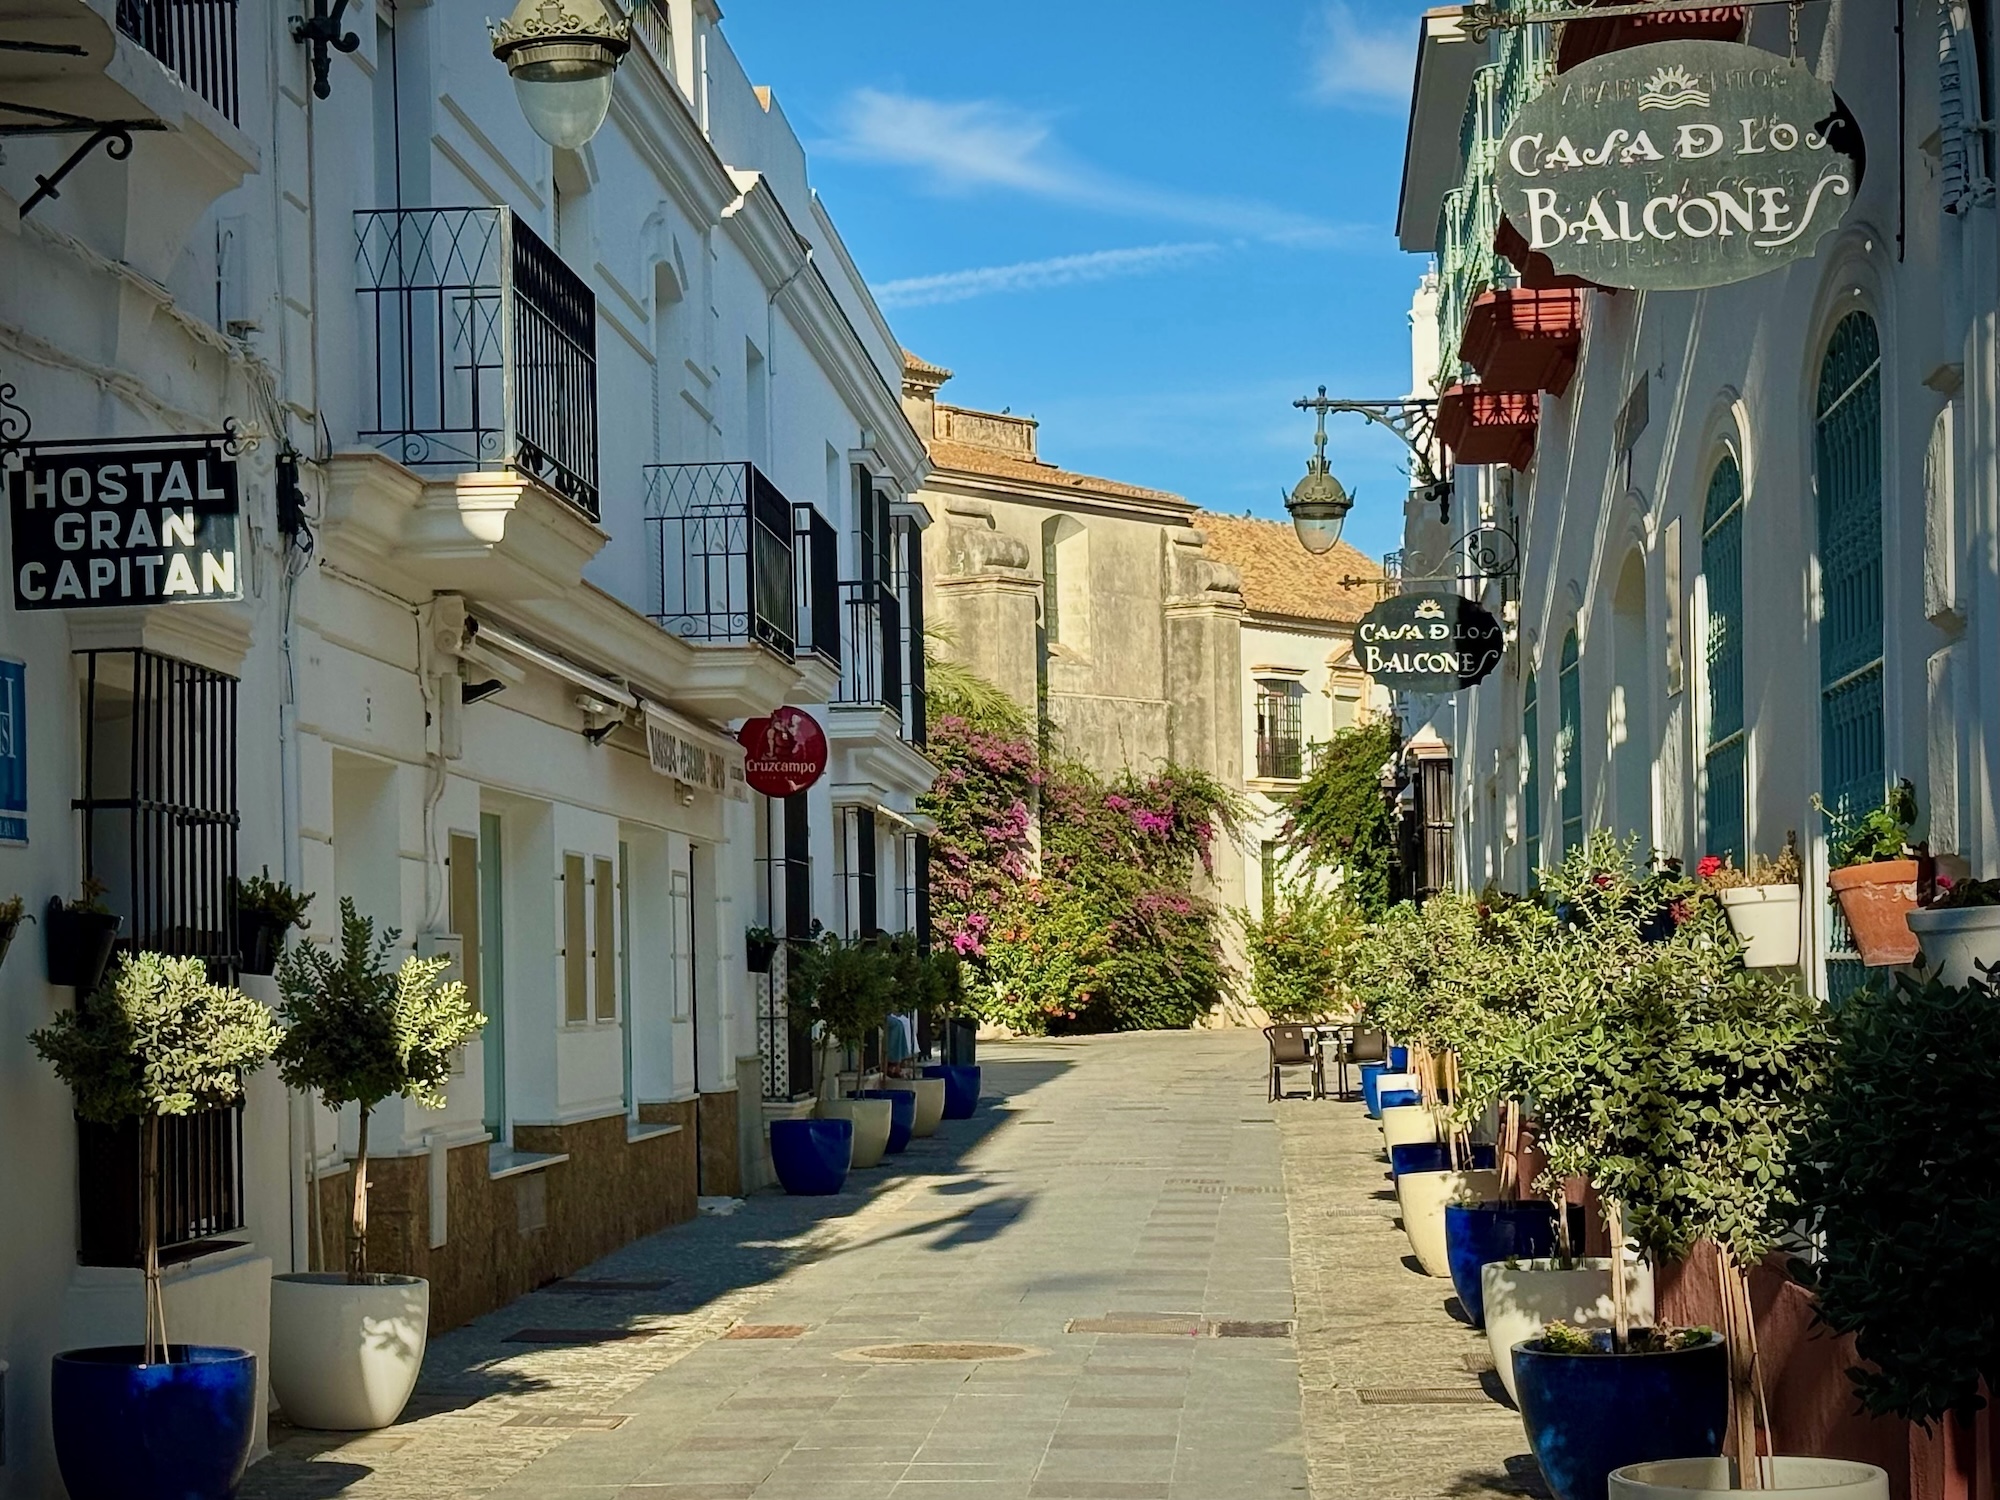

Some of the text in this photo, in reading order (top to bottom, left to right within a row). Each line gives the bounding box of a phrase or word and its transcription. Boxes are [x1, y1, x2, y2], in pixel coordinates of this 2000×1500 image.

[1508, 128, 1665, 177] CASA
[1735, 117, 1846, 155] LOS
[1520, 173, 1850, 251] BALCONES
[25, 458, 226, 510] HOSTAL
[54, 505, 196, 551] GRAN
[19, 550, 236, 601] CAPITAN
[1359, 622, 1425, 643] CASA
[1452, 623, 1500, 640] LOS
[1364, 645, 1499, 678] BALCONES
[746, 758, 817, 775] Cruzcampo
